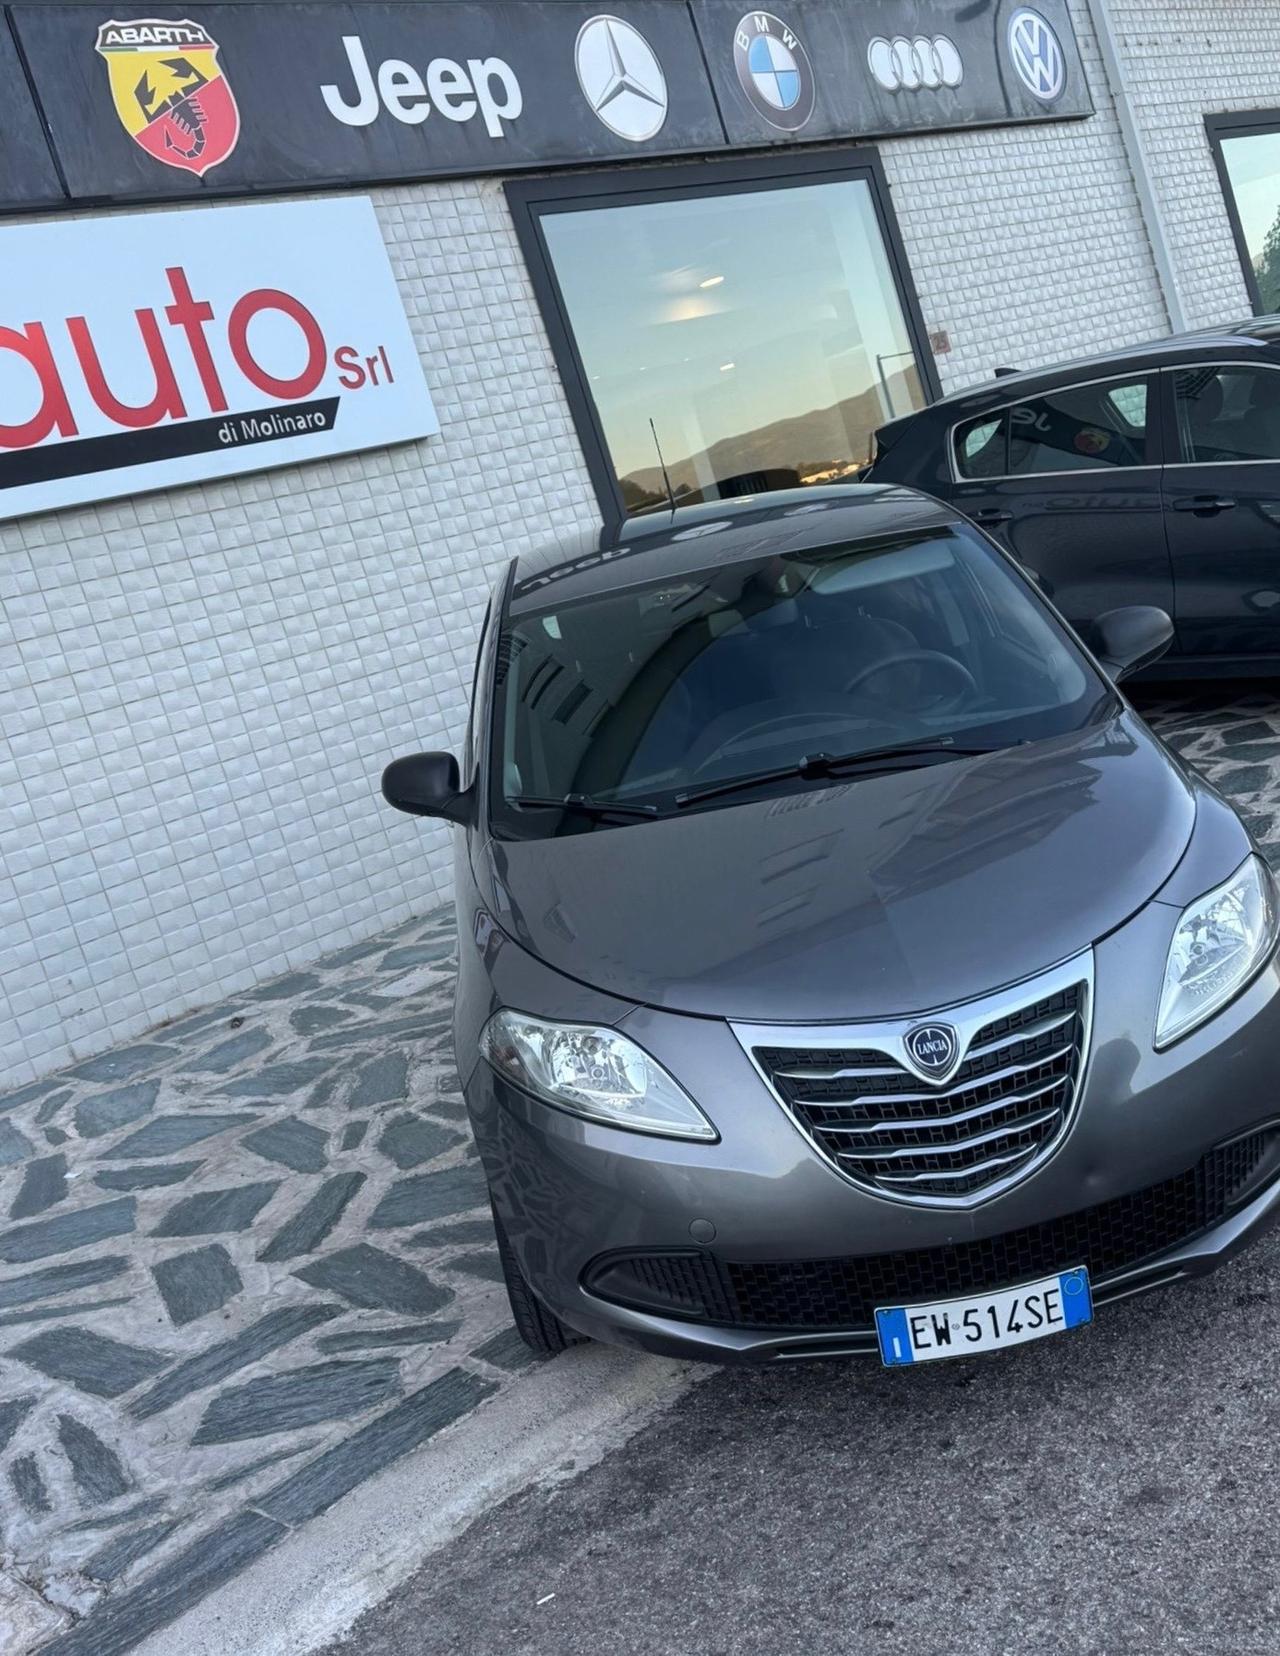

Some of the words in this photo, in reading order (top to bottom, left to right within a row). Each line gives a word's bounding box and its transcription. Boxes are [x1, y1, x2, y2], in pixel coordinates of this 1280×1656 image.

[105, 26, 205, 45] ABARTH
[736, 15, 798, 52] BMW
[319, 35, 523, 138] Jeep
[333, 345, 395, 390] Srl
[218, 422, 239, 444] di
[241, 411, 327, 440] Molinaro
[917, 1039, 948, 1055] LANCIA
[909, 1312, 952, 1350] EW
[962, 1288, 1064, 1343] 514SE
